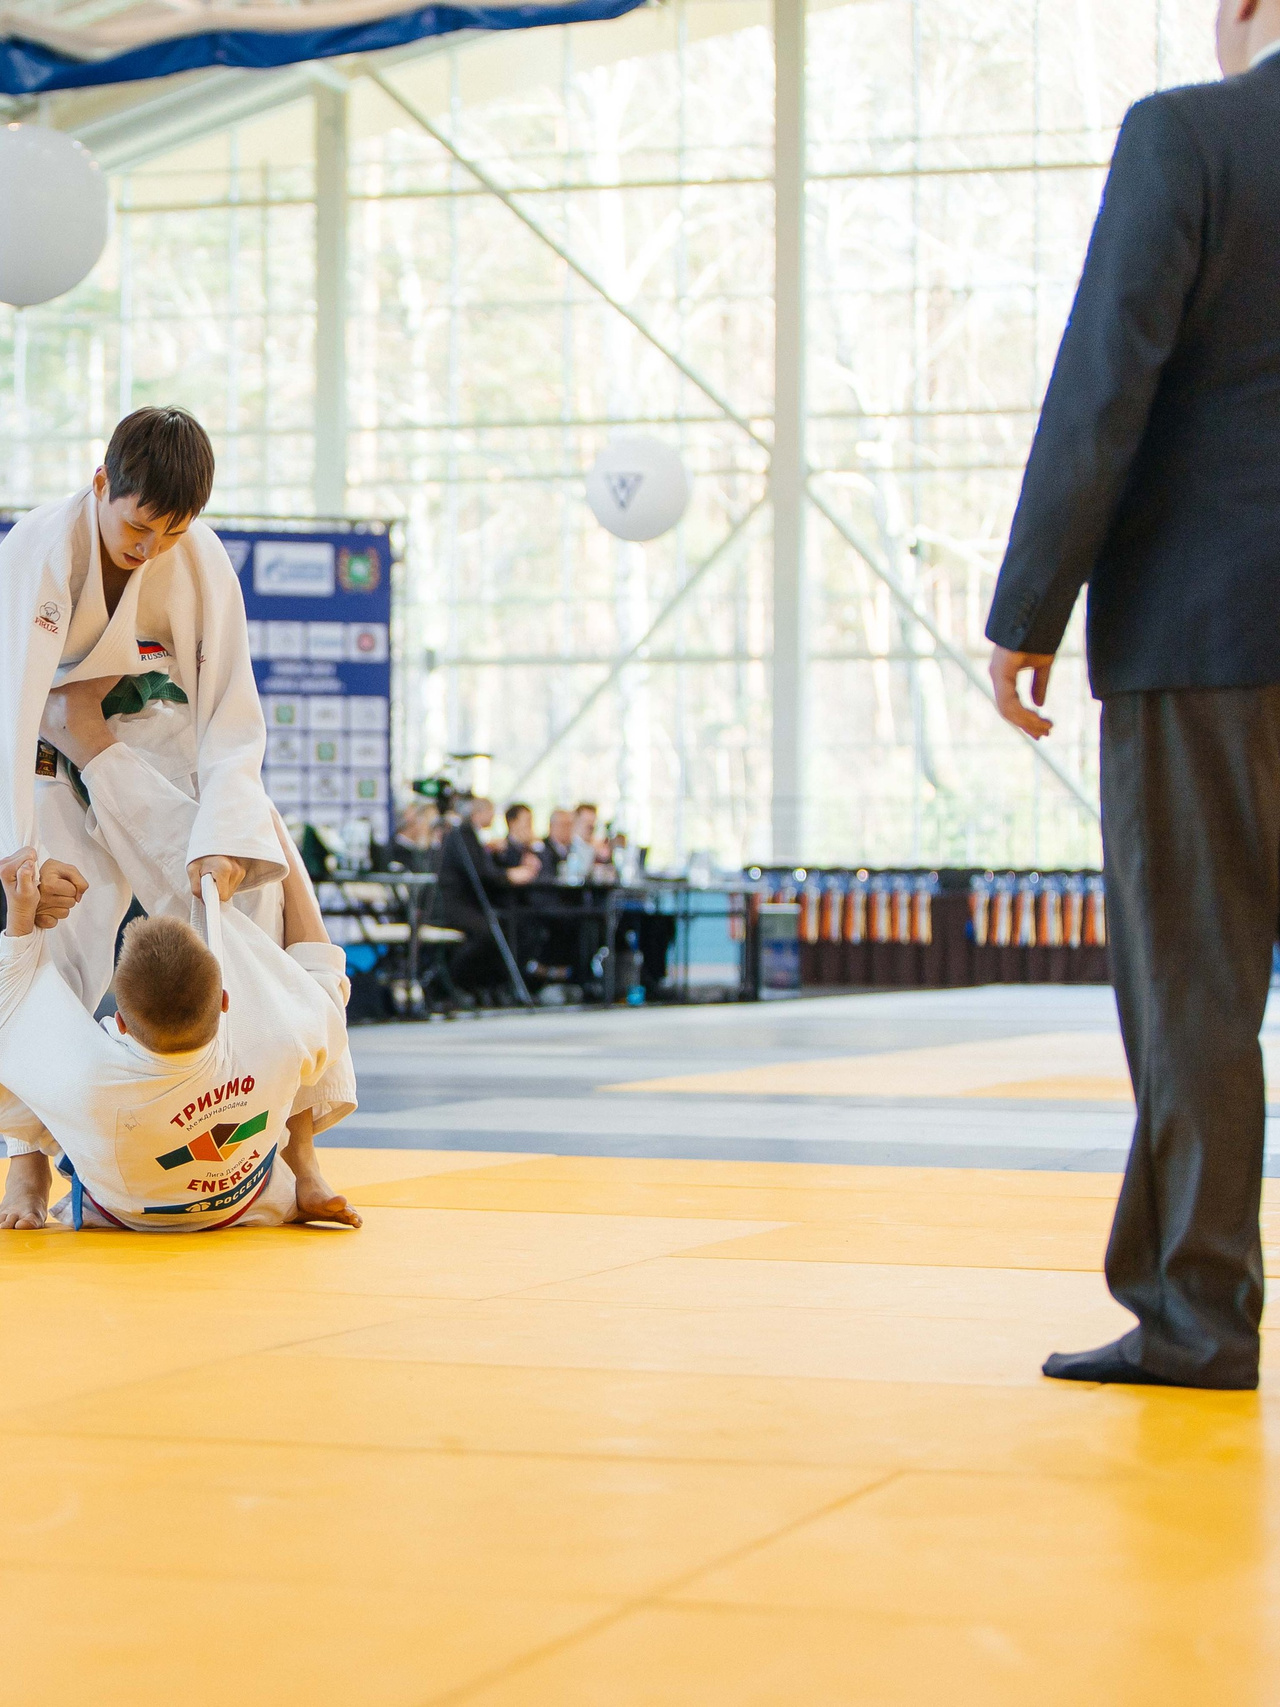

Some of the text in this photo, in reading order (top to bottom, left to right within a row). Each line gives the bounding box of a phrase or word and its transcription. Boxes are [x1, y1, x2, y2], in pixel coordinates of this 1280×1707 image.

[169, 1075, 255, 1128] ТРИУМФ
[186, 1101, 248, 1132] Международная
[186, 1149, 260, 1193] ENERGY
[214, 1166, 264, 1207] РОССЕТИ
